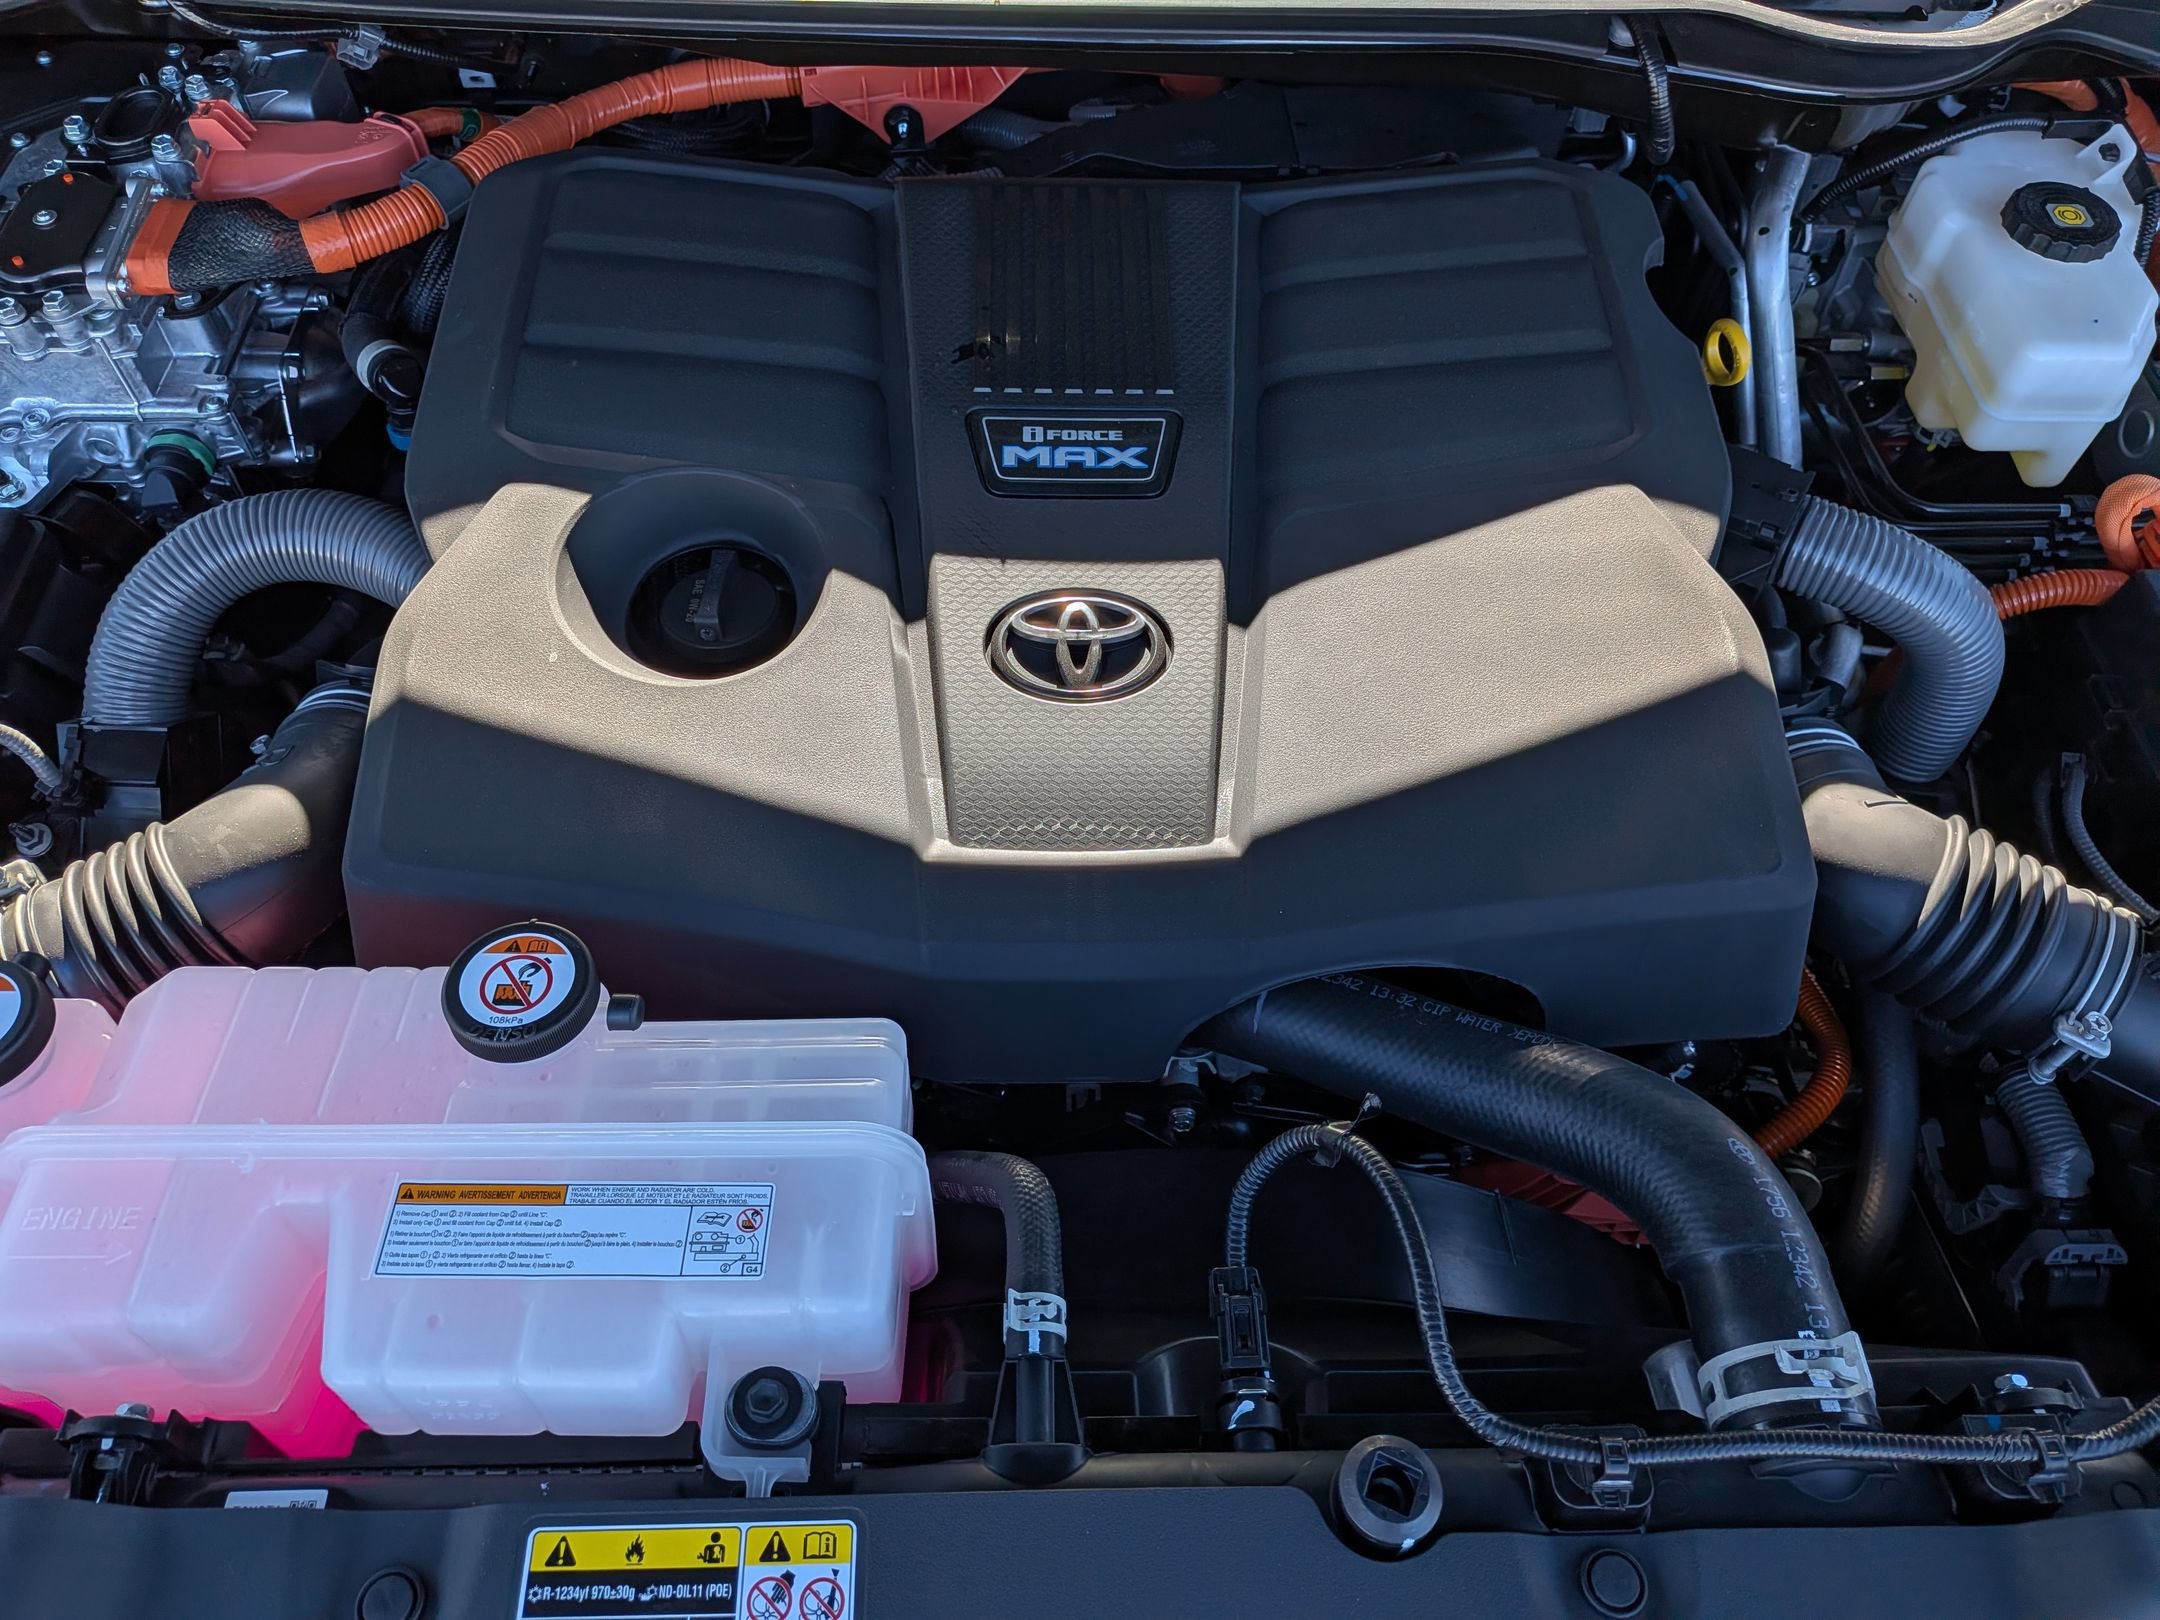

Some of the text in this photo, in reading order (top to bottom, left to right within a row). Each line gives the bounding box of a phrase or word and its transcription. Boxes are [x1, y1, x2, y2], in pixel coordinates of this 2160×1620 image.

[1046, 429, 1124, 441] FORCE
[1001, 444, 1149, 469] MAX
[692, 579, 706, 594] SAE
[1313, 974, 1363, 991] 2342
[1369, 984, 1417, 1008] 13:32
[1422, 1000, 1452, 1018] CIP
[1455, 1012, 1503, 1034] WATER
[489, 1016, 524, 1024] 108kPa
[465, 1025, 537, 1042] DENSO
[417, 1190, 561, 1200] WARNING AVERTISSEMENT ADVERTENCIA
[20, 1206, 143, 1230] ENGINE
[421, 1211, 430, 1219] Cap
[500, 1211, 509, 1219] Cap
[544, 1220, 554, 1228] Cap
[1753, 1176, 1793, 1218] 1756
[1780, 1229, 1819, 1289] 12342
[542, 1583, 732, 1603] R-1234yf 970±30g ND-OIL11 (POE)
